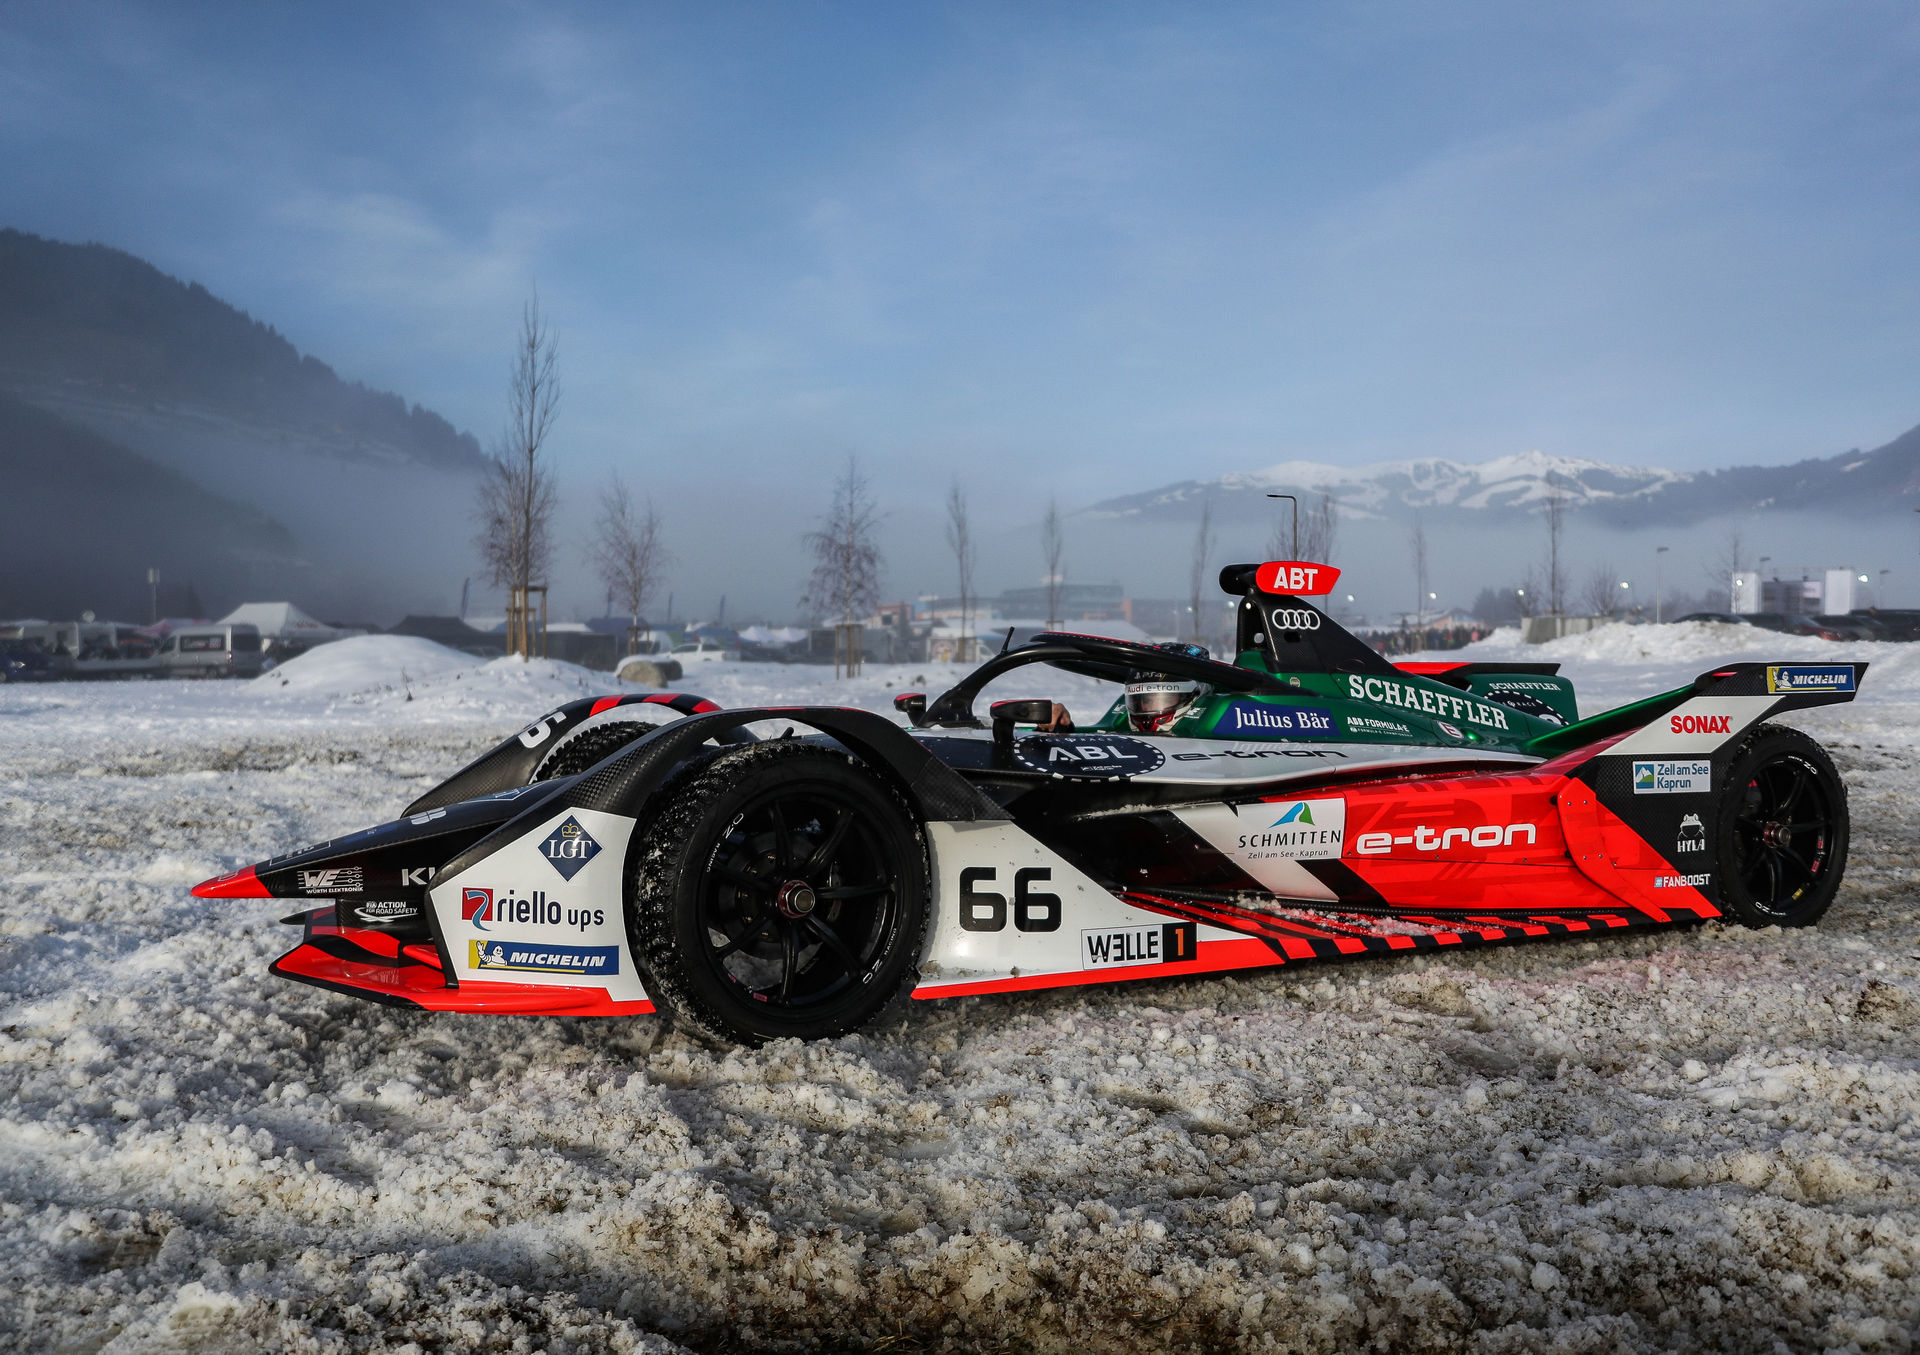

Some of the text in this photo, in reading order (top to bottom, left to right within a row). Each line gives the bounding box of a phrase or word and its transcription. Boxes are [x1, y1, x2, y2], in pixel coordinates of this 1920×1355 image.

[1273, 566, 1319, 591] ABT
[1489, 682, 1561, 691] SCHAEFFLER
[1792, 675, 1847, 685] MICHELIN
[1127, 684, 1180, 693] Audi e-tron
[1349, 674, 1509, 731] SCHAEFFLER
[1235, 707, 1330, 730] Julius Bär
[1347, 716, 1364, 726] ABB
[1671, 715, 1731, 734] SONAX
[1048, 745, 1138, 761] ABL
[1172, 750, 1349, 761] e-tron
[1657, 763, 1709, 775] Zell am See
[1657, 776, 1692, 791] Kaprun
[1238, 830, 1342, 848] SCHMITTEN
[1356, 823, 1537, 855] e-tron
[1677, 839, 1705, 852] HYLA
[548, 839, 592, 859] LGT
[1248, 851, 1263, 859] Zell
[306, 886, 364, 894] WÜRTH ELEKTRONIK
[378, 901, 407, 909] ACTION
[960, 866, 1063, 932] 66
[497, 889, 604, 932] riello ups
[1174, 928, 1184, 956] 1
[510, 951, 606, 967] MICHELIN
